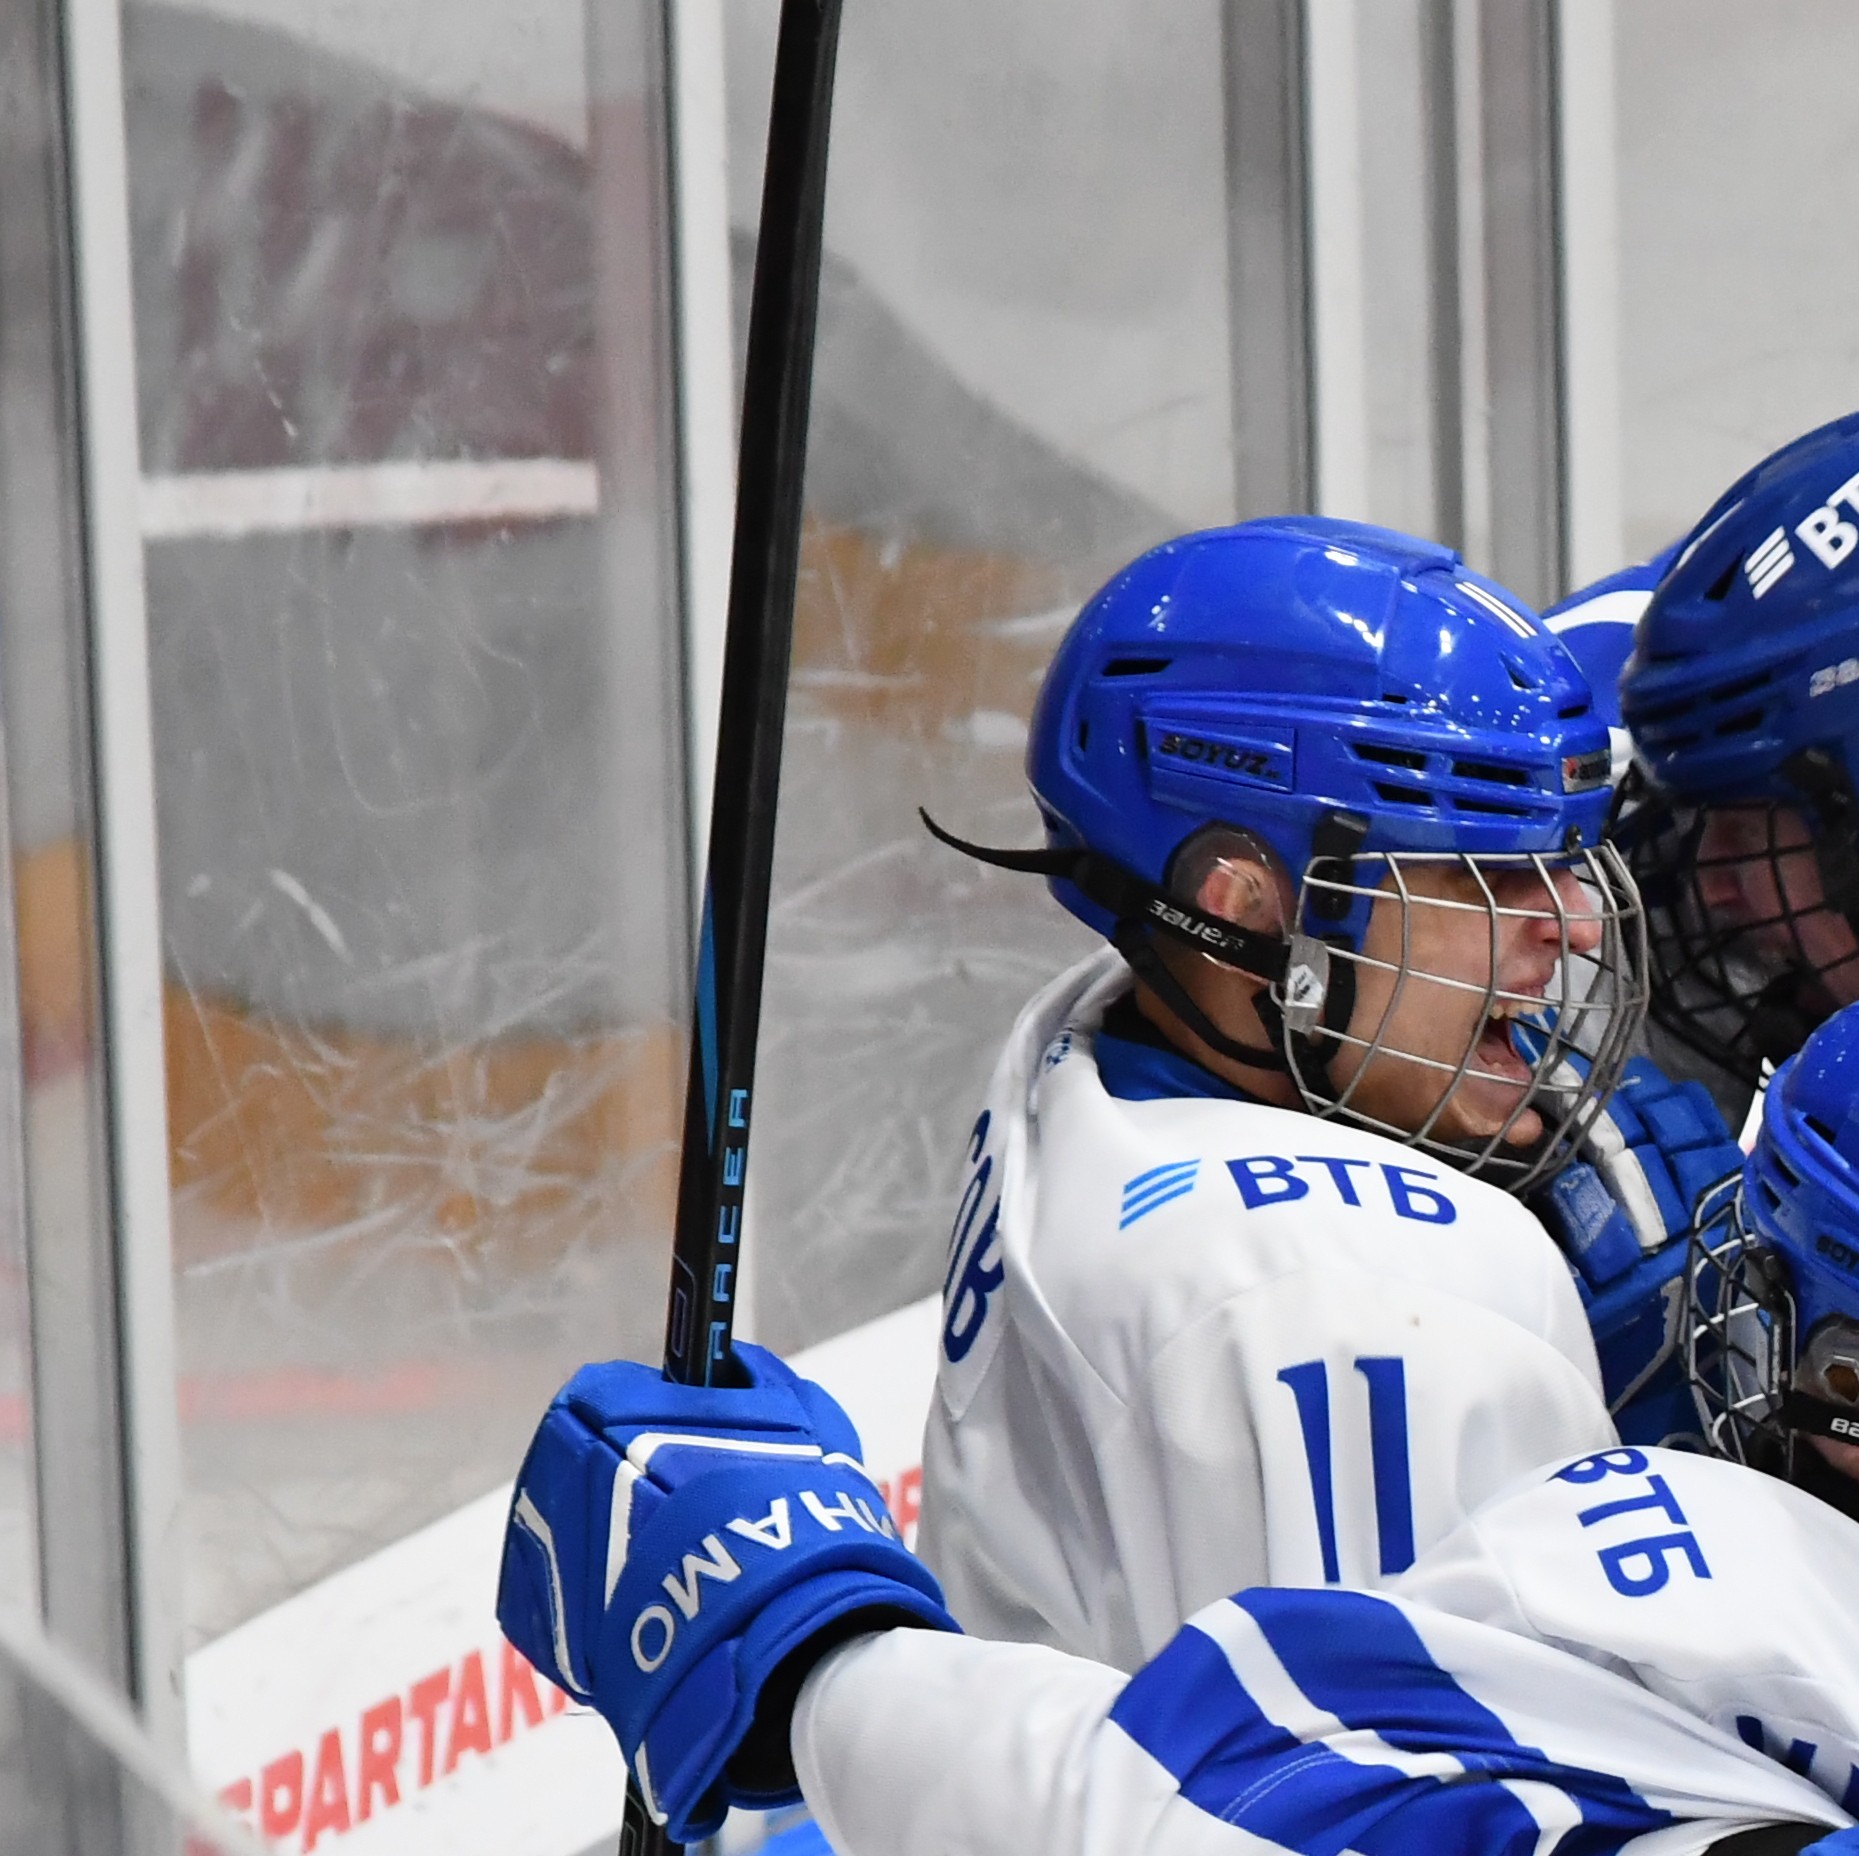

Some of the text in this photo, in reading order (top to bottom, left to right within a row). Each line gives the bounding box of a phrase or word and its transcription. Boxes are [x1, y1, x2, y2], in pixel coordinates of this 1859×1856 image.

[1160, 734, 1269, 773] SOYUZ
[1147, 900, 1246, 950] BAUER
[705, 1089, 749, 1387] RACER
[1225, 1155, 1457, 1225] ВТБ
[1276, 1356, 1416, 1584] 11
[1545, 1448, 1713, 1597] ВТБ
